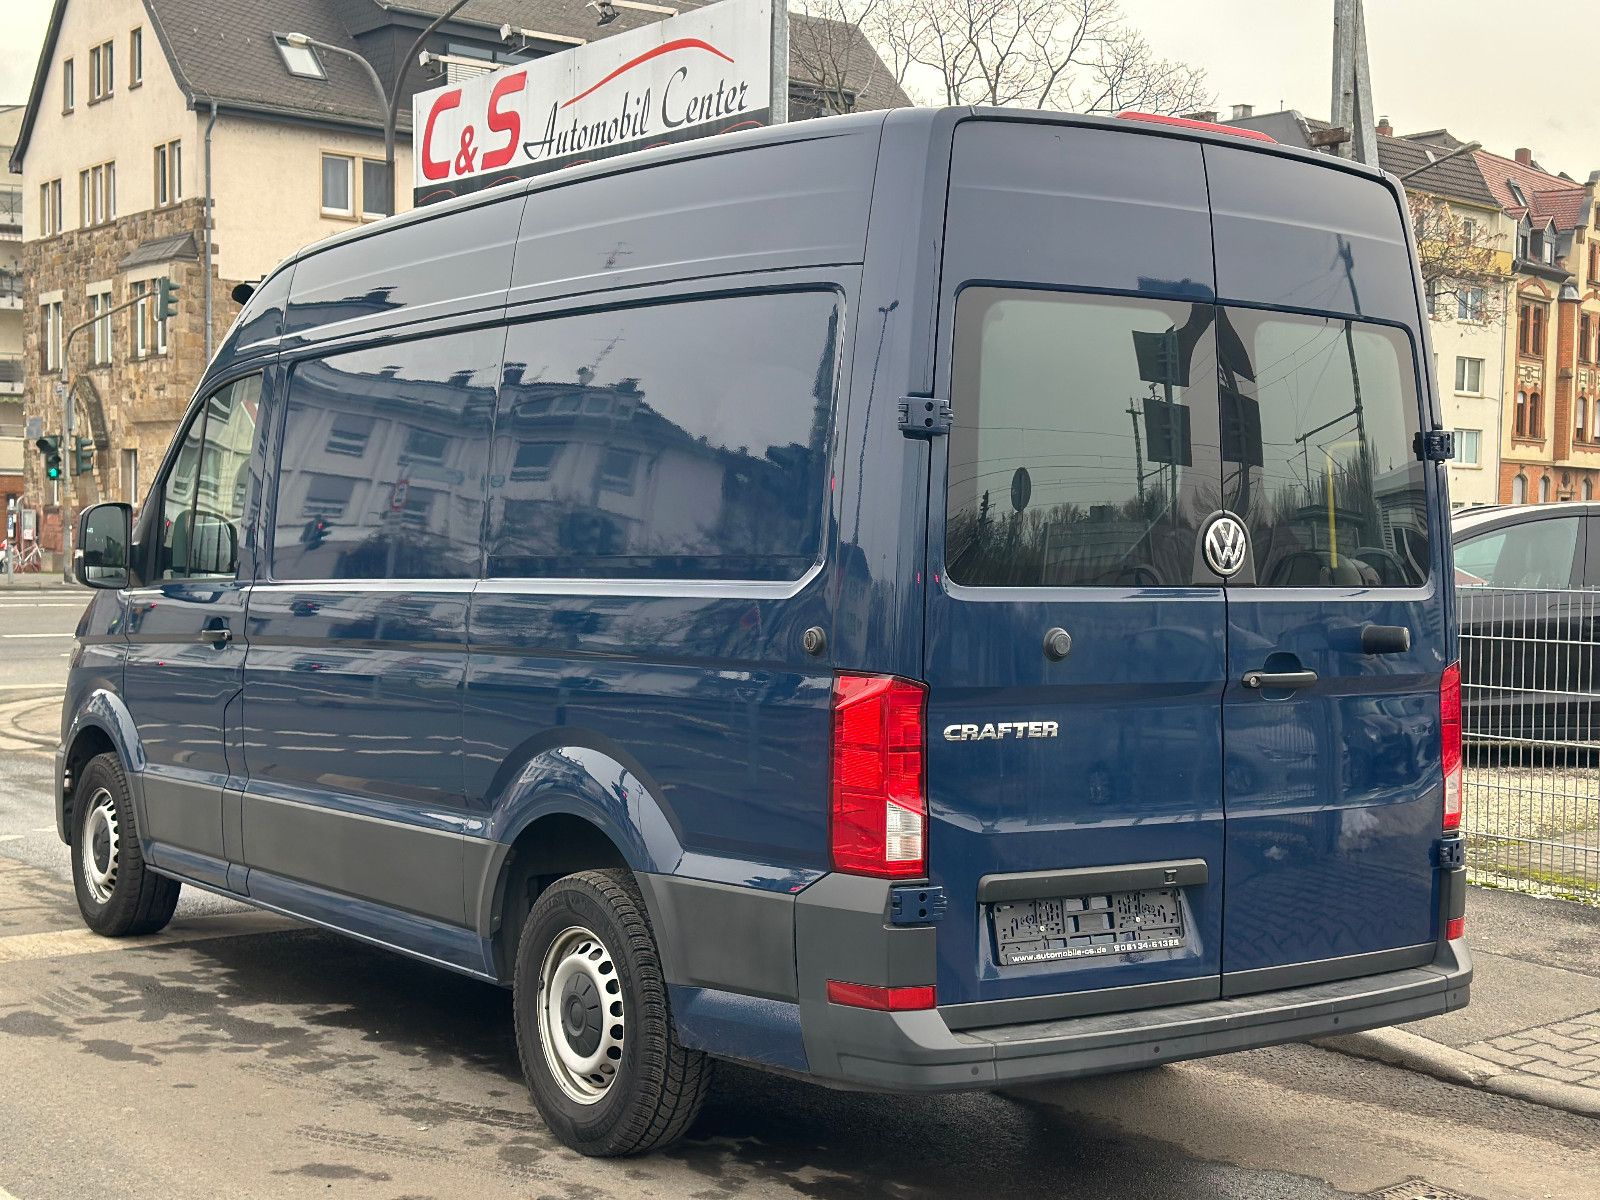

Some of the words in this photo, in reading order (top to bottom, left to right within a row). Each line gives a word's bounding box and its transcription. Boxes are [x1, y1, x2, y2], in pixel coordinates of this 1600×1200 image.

[422, 71, 527, 181] C&S
[522, 88, 651, 160] Automobil
[661, 66, 748, 128] Center
[943, 720, 1059, 742] CRAFTER
[1011, 946, 1107, 962] www.automobile-cs.de
